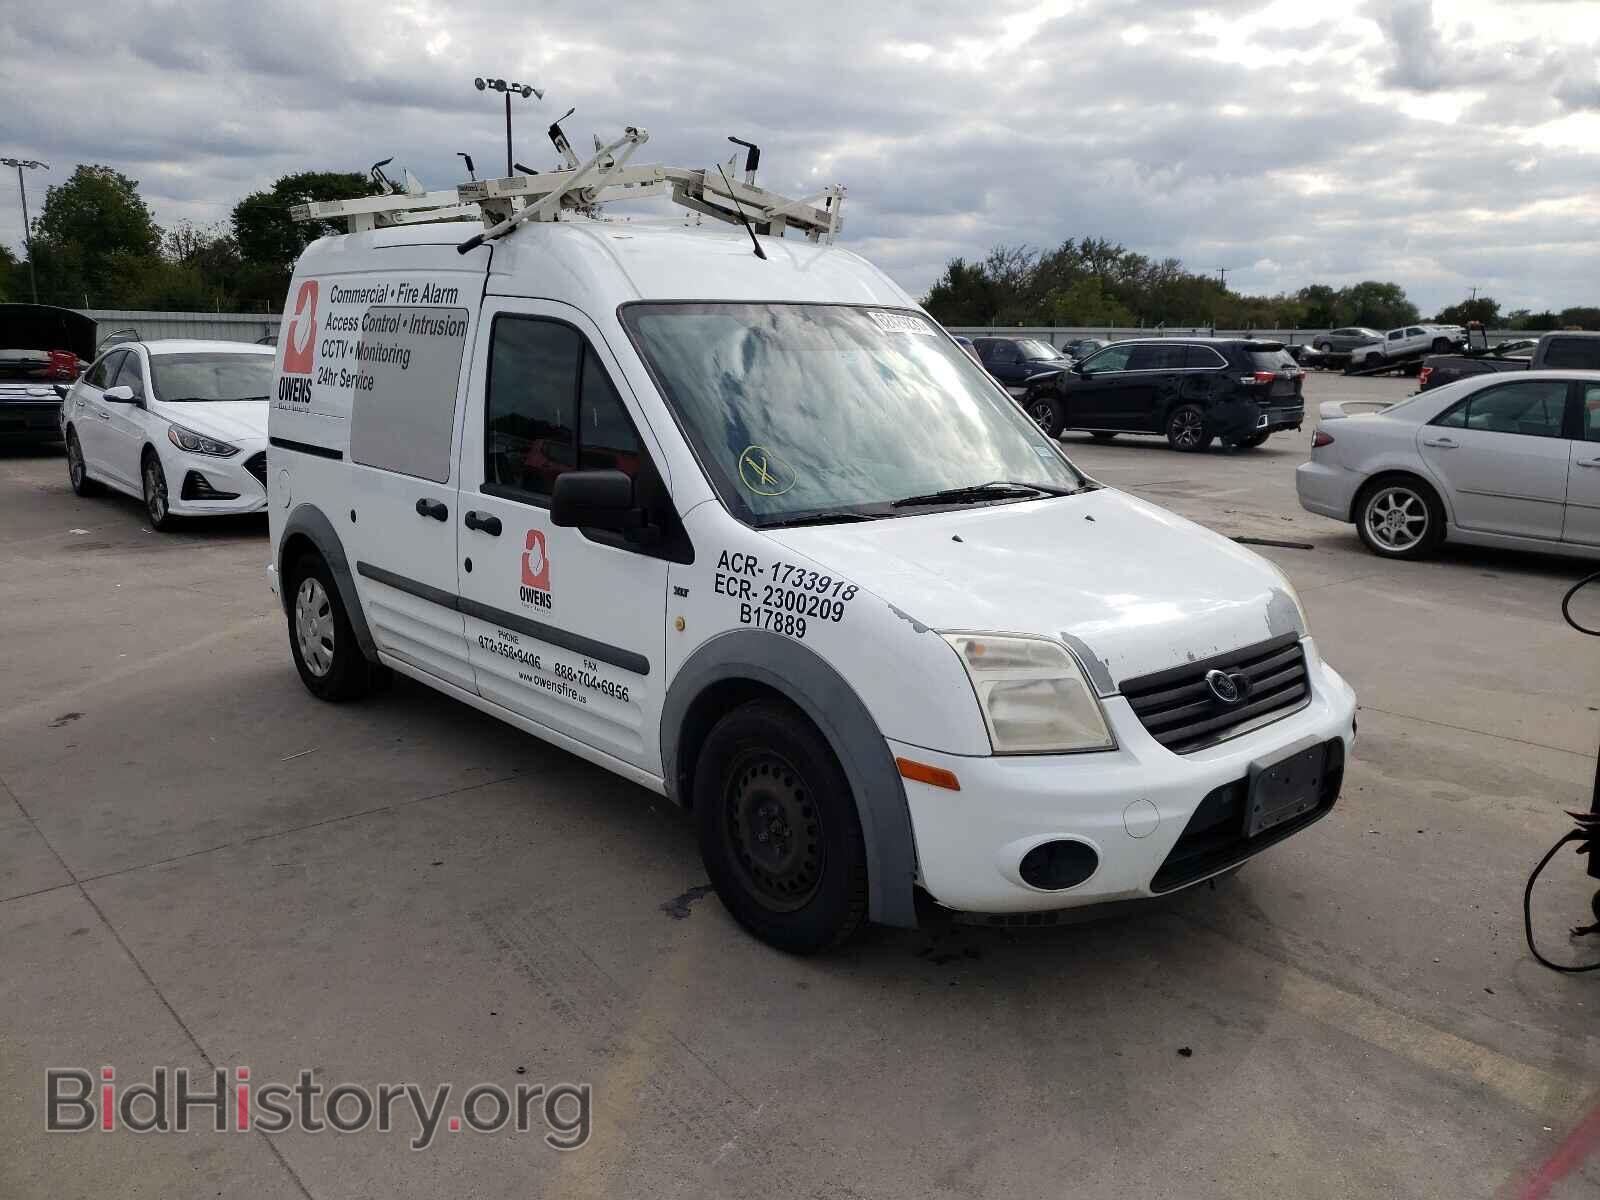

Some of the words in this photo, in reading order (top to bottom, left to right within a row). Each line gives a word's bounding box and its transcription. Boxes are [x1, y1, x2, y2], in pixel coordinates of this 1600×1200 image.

[330, 284, 389, 304] Commercial
[397, 283, 419, 304] Fire
[420, 283, 459, 304] Alarm
[325, 312, 359, 332] Access
[361, 313, 401, 333] Control
[408, 314, 467, 337] Intrusion
[321, 339, 349, 358] CCTV
[354, 341, 411, 370] Monitoring
[279, 376, 312, 403] OWENS
[317, 366, 338, 387] 24hr
[339, 369, 374, 391] Service
[717, 550, 764, 577] ACR-
[771, 561, 859, 601] 1733918
[520, 586, 552, 609] OWENS
[714, 573, 758, 601] ECR-
[763, 585, 845, 622] 2300209
[740, 603, 807, 638] B17889
[498, 630, 519, 645] PHONE
[583, 659, 598, 672] FAX
